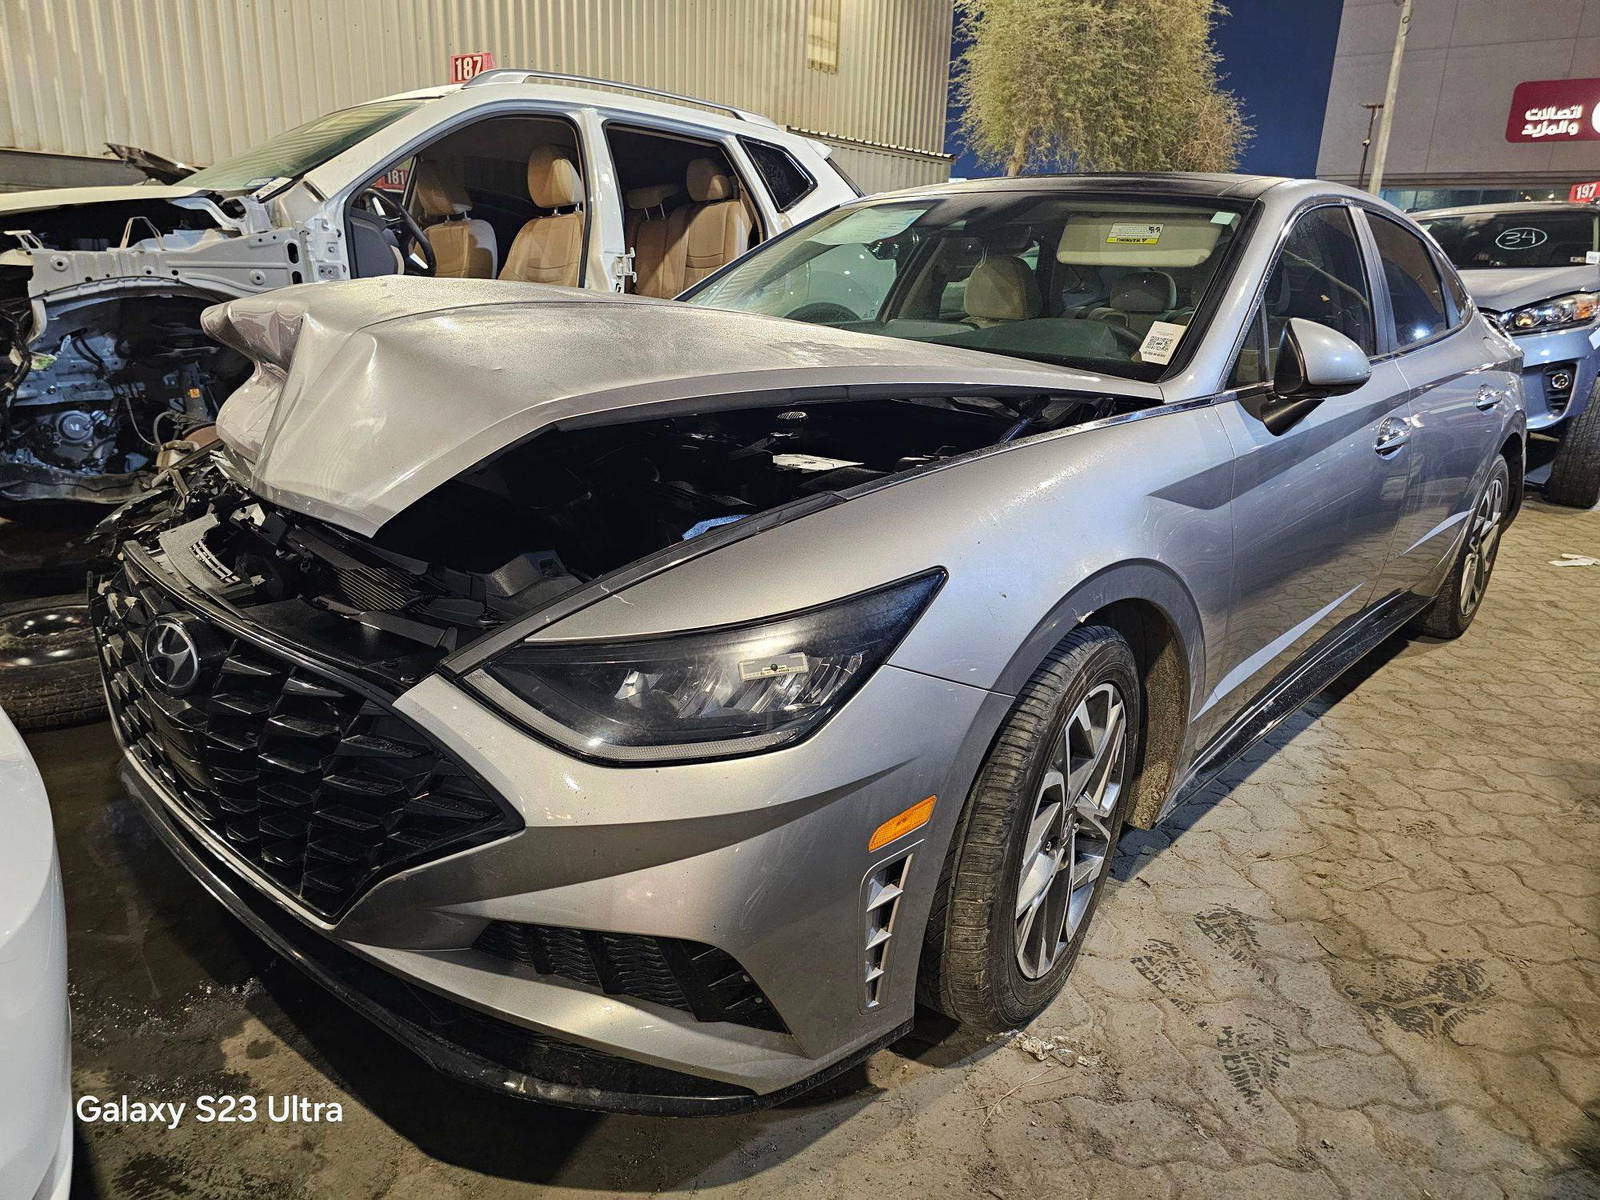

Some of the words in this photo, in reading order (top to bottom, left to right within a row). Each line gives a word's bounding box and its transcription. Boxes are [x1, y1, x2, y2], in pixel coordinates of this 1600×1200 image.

[455, 55, 482, 81] 187
[1524, 104, 1583, 121] اتصالات
[1521, 120, 1580, 138] والمزيد
[387, 170, 405, 185] 181
[1576, 183, 1597, 200] 197
[1504, 231, 1536, 245] 34
